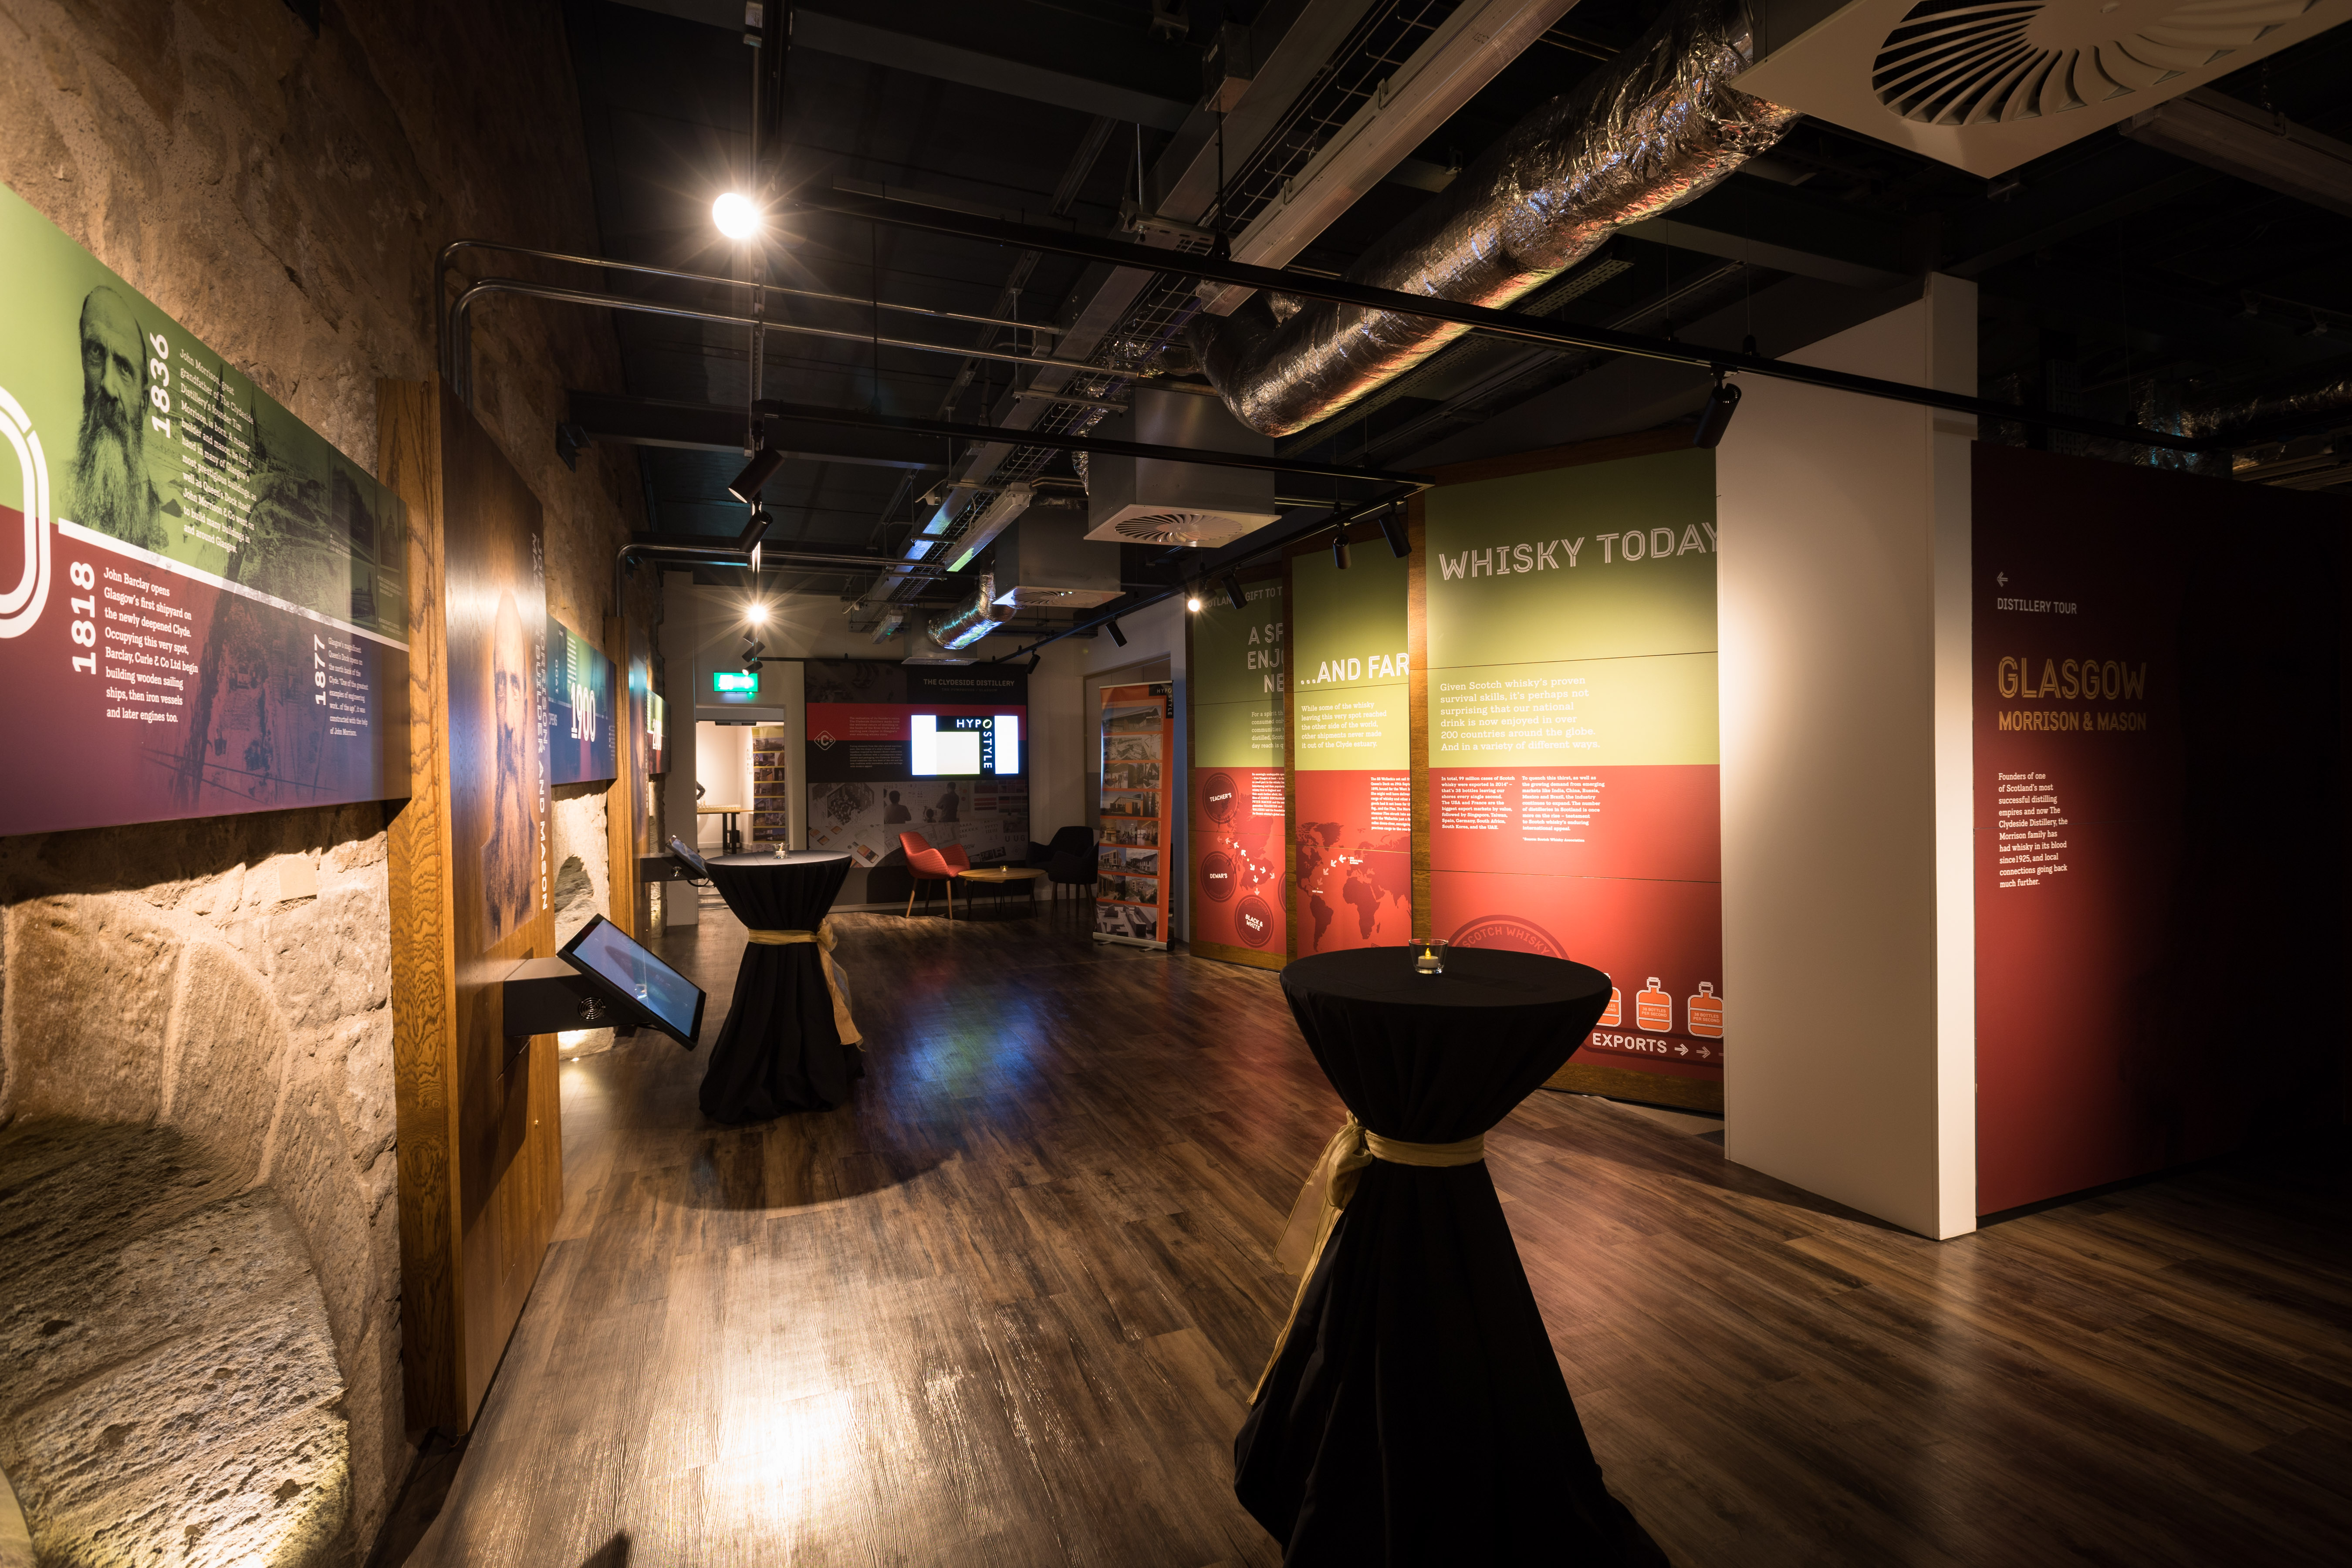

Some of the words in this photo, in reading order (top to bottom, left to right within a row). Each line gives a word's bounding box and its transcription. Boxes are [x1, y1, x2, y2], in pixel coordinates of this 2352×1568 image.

[150, 332, 170, 439] 1836
[1439, 537, 1585, 581] WHISKY
[103, 567, 122, 582] John
[123, 573, 150, 593] Barclay
[151, 584, 170, 597] opens
[1245, 589, 1263, 602] GIFT
[1265, 588, 1275, 598] TO
[104, 587, 139, 606] Glasgow's
[141, 597, 155, 611] first
[156, 602, 183, 618] shipyard
[184, 612, 192, 620] on
[1997, 598, 2051, 612] DISTILLERY
[2054, 602, 2077, 614] TOUR
[70, 561, 96, 675] 1818
[104, 607, 117, 620] the
[118, 613, 140, 628] newly
[141, 616, 172, 633] deepened
[173, 624, 192, 638] Clyde.
[105, 626, 143, 648] Occupying
[144, 635, 157, 648] this
[158, 641, 173, 653] very
[174, 644, 189, 656] spot,
[1248, 626, 1260, 645] A
[105, 646, 134, 664] Barclay,
[135, 652, 153, 665] Curle
[160, 656, 169, 668] Co
[170, 659, 181, 670] Ltd
[182, 660, 198, 675] begin
[1369, 653, 1409, 679] FAR
[314, 634, 326, 705] 1877
[1440, 683, 1467, 691] Given
[1469, 680, 1502, 689] Scotch
[1504, 678, 1548, 689] whisky's
[1550, 678, 1586, 688] proven
[1998, 656, 2146, 700] GLASGOW
[1440, 693, 1477, 703] survival
[1480, 692, 1507, 702] skills,
[1509, 691, 1525, 700] it's
[1528, 690, 1568, 702] perhaps
[1572, 689, 1589, 697] not
[571, 683, 596, 742] 1900
[1301, 714, 1321, 722] leaving
[1348, 712, 1362, 720] spot
[1363, 710, 1387, 718] reached
[1440, 706, 1488, 716] surprising
[1490, 705, 1511, 713] that
[1533, 702, 1574, 711] national
[956, 719, 992, 729] HYPO
[1440, 718, 1466, 727] drink
[1501, 716, 1539, 727] enjoyed
[1999, 711, 2079, 731] MORRISON
[2082, 712, 2094, 731] &
[2097, 712, 2146, 731] MASON
[983, 731, 992, 768] STYLE
[1998, 772, 2026, 781] Founders
[2006, 784, 2038, 792] Scotland's
[1210, 792, 1232, 802] TEACHER'S
[1998, 795, 2030, 804] successful
[2031, 795, 2058, 804] distilling
[1999, 808, 2023, 818] empires
[1999, 819, 2028, 830] Clydeside
[2029, 818, 2058, 828] Distillery,
[1999, 832, 2027, 840] Morrison
[2028, 830, 2046, 839] family
[1999, 844, 2011, 852] had
[2011, 843, 2034, 852] whisky
[2051, 840, 2067, 849] blood
[1245, 914, 1260, 926] BLACK
[1246, 920, 1260, 931] WHITE
[1462, 926, 1502, 949] SCOTCH
[1506, 926, 1551, 955] WHISKY
[1592, 1033, 1667, 1053] EXPORTS
